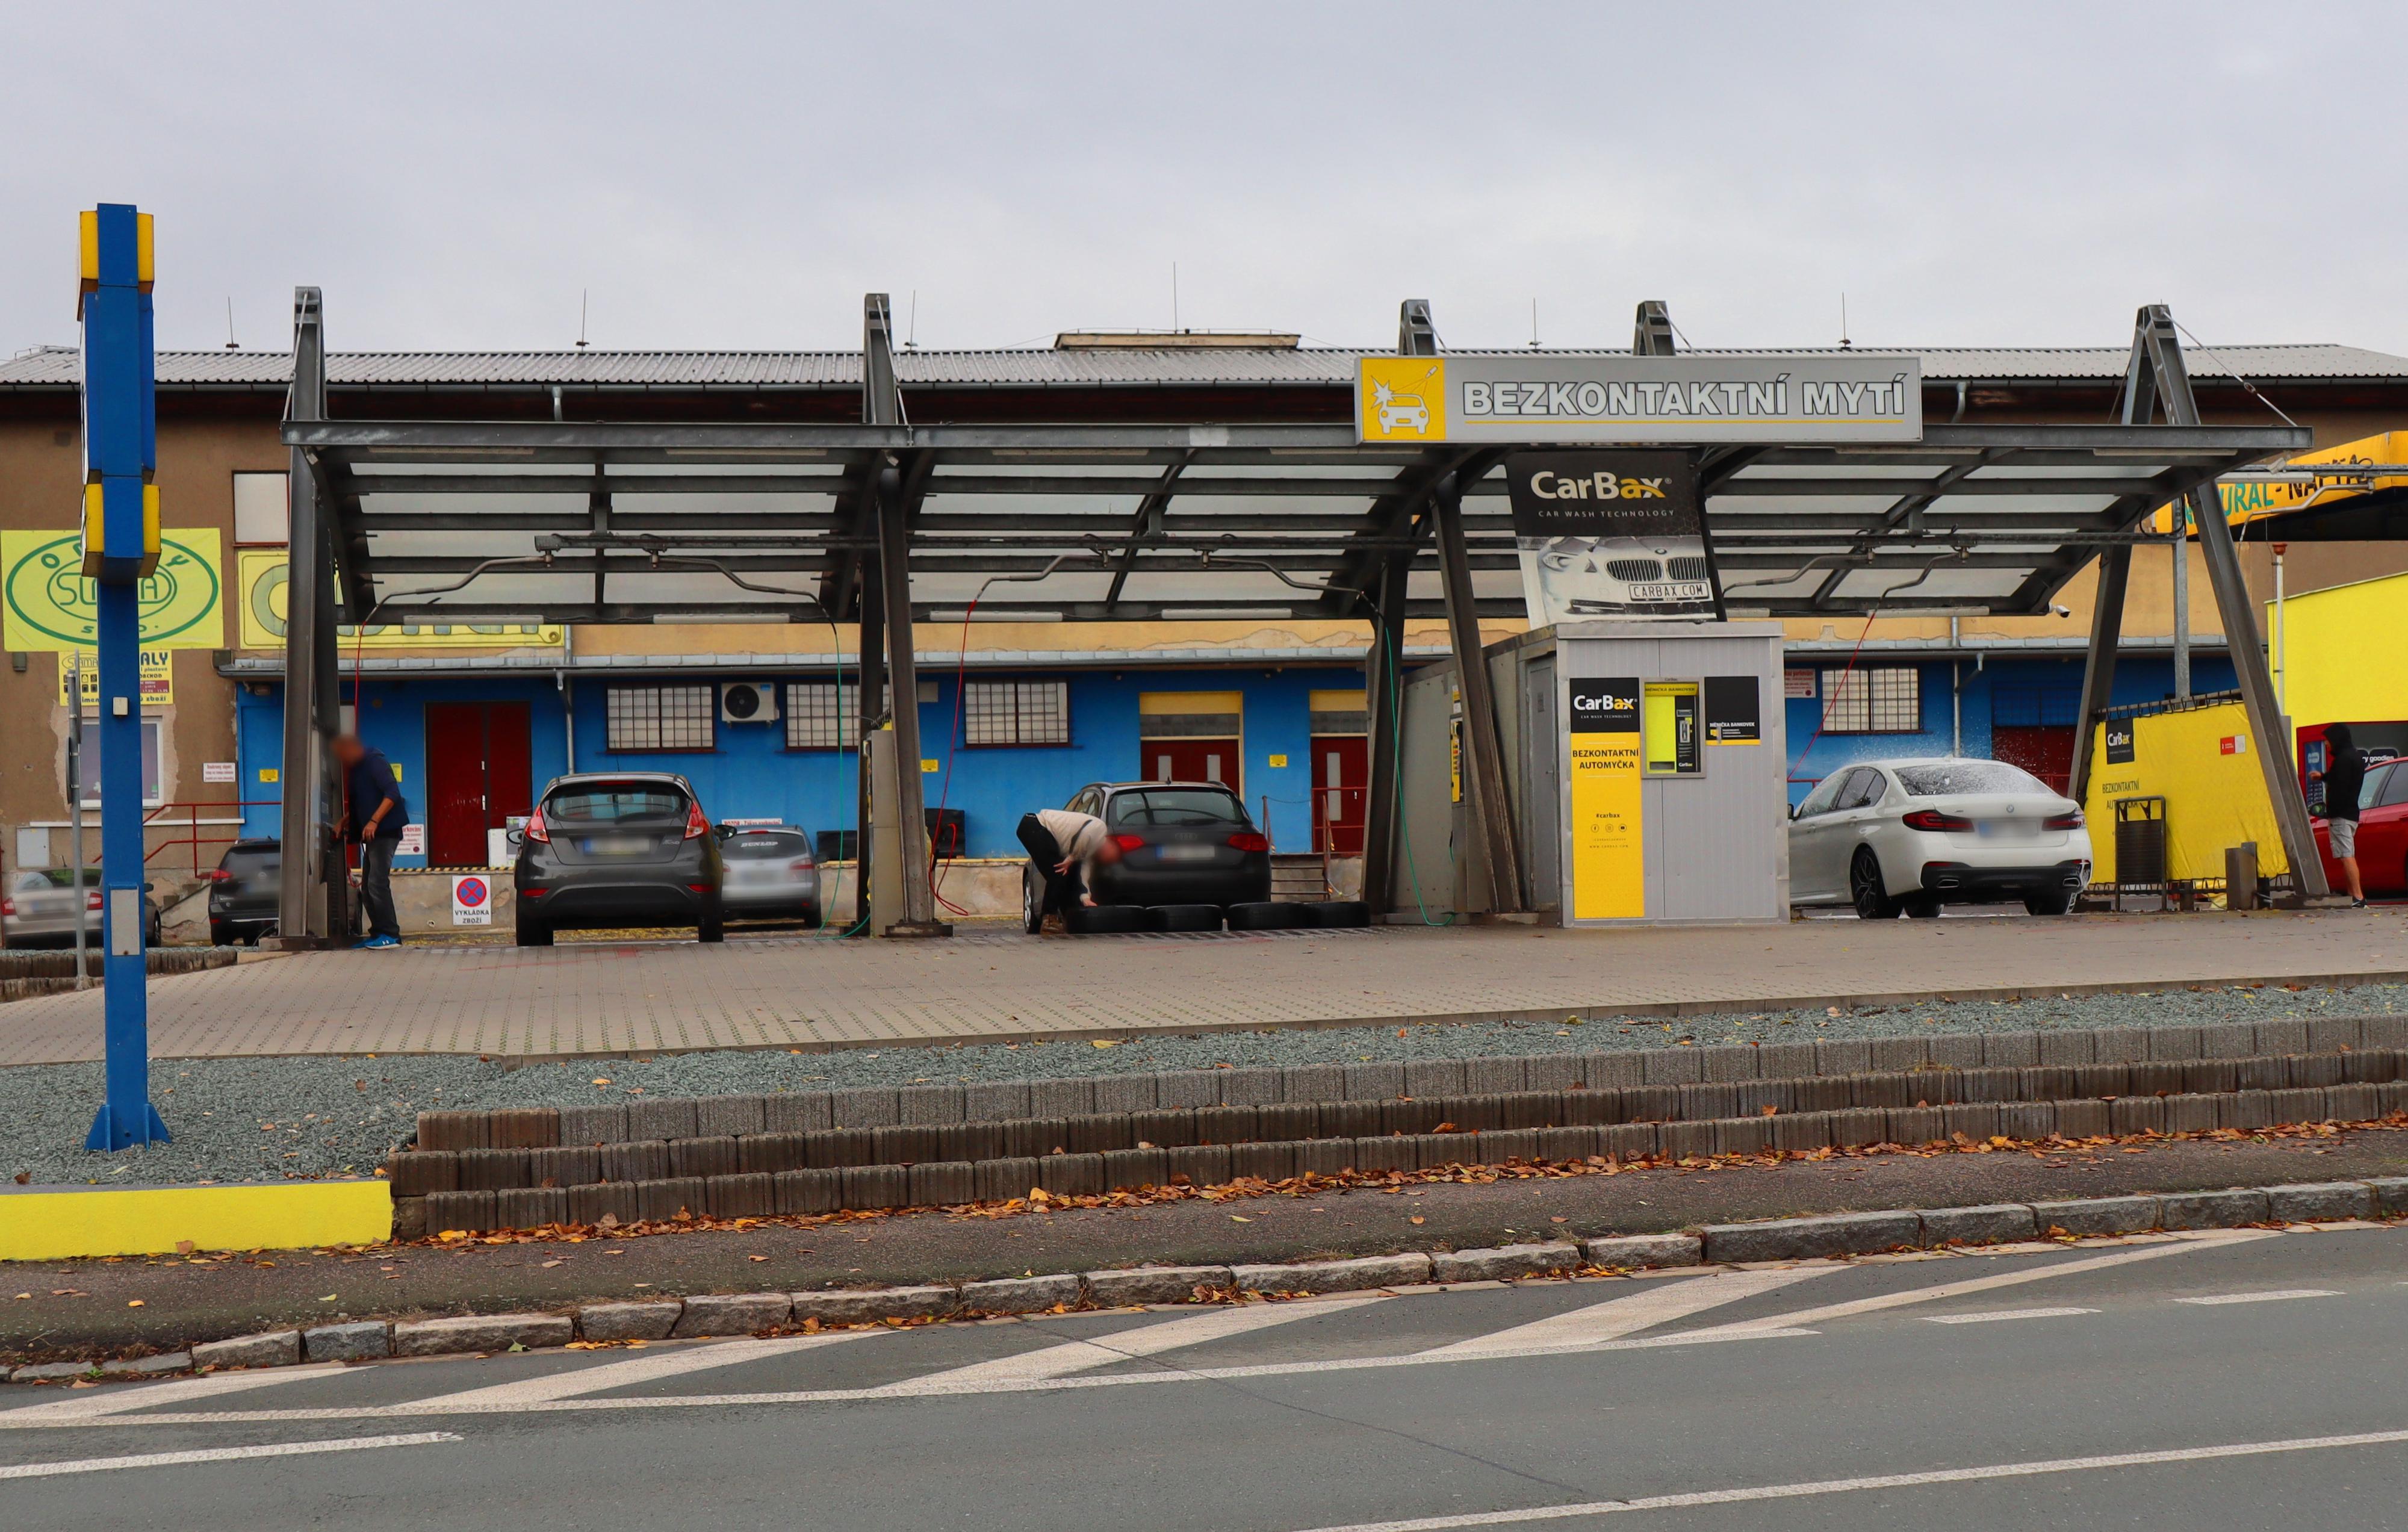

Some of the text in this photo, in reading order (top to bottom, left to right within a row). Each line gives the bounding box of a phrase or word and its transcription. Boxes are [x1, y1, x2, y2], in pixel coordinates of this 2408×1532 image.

[1463, 373, 1908, 415] BEZKONTAKTNÍ MYTÍ
[1601, 509, 1674, 518] TECHNOLOGY
[1633, 584, 1704, 597] CARBAX.COM
[140, 652, 168, 665] ALY
[1572, 748, 1639, 757] BEZKONTAKTNÍ
[1579, 760, 1635, 769] AUTOMYČKA
[2102, 778, 2140, 794] BEZKONTAKTNÍ
